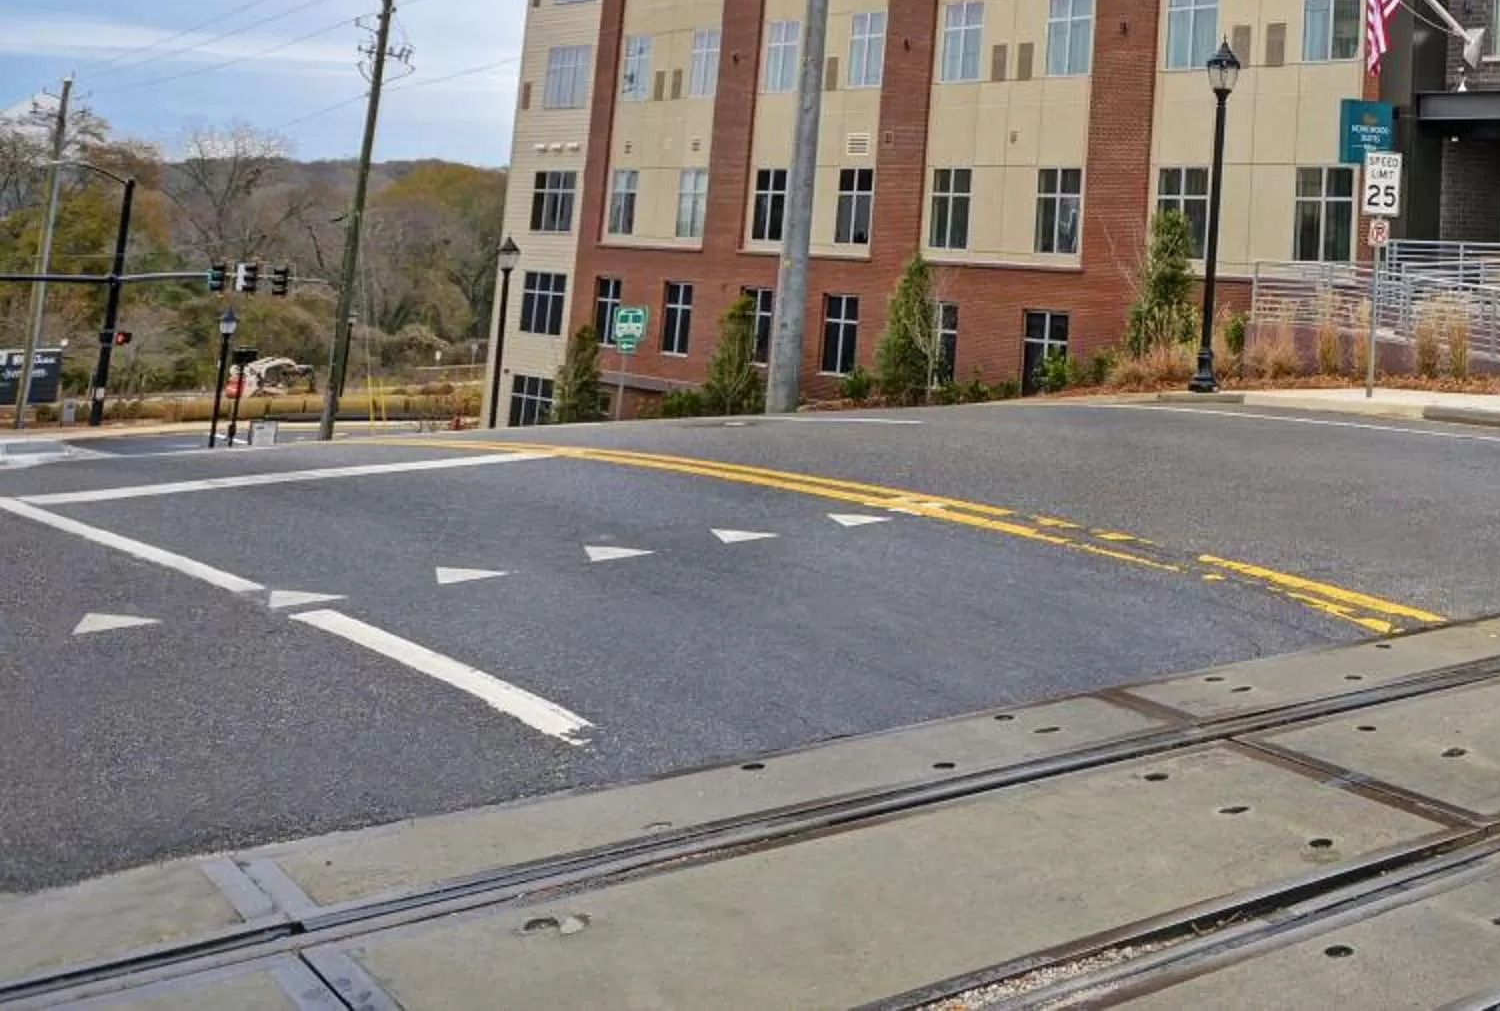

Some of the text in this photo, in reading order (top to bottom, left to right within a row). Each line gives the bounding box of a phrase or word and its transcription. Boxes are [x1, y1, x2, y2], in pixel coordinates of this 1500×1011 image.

[1368, 156, 1399, 168] SPEED
[1370, 169, 1396, 180] LIMIT
[1367, 184, 1397, 208] 25
